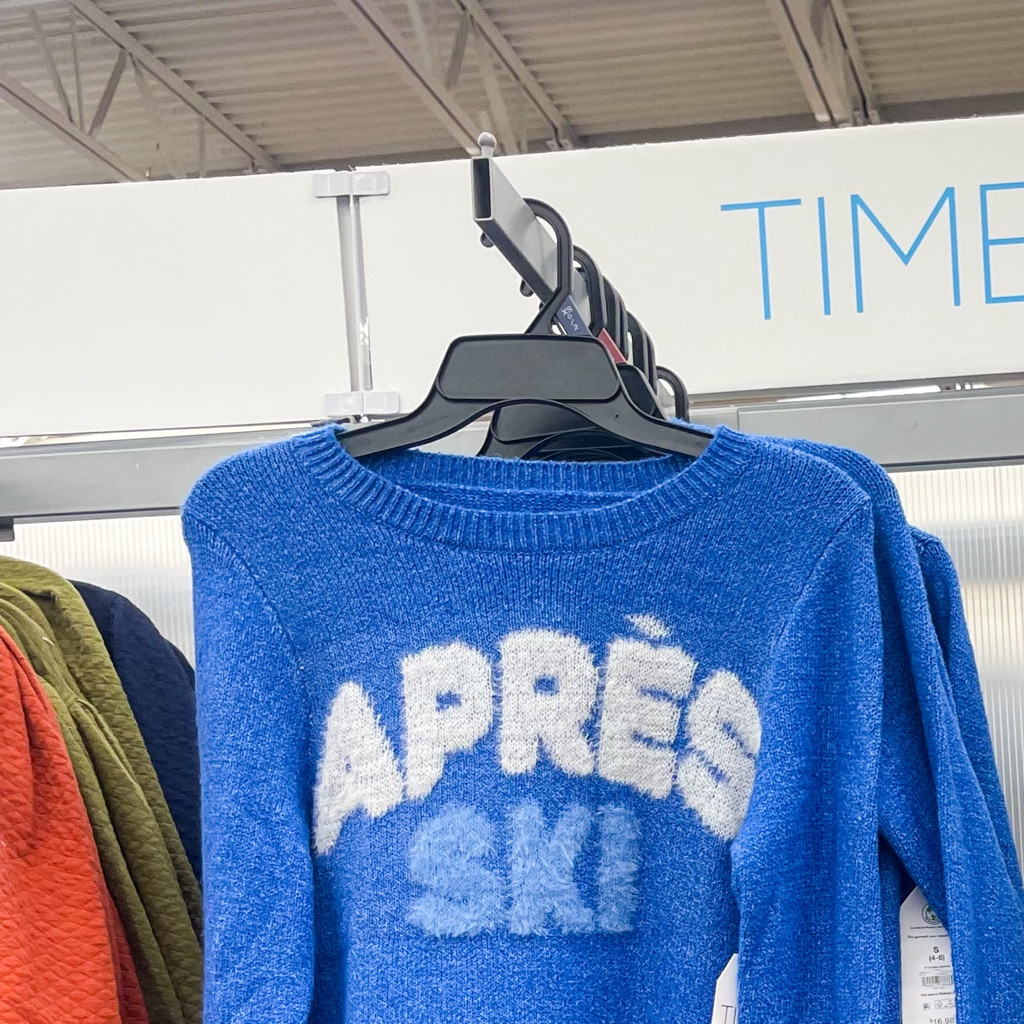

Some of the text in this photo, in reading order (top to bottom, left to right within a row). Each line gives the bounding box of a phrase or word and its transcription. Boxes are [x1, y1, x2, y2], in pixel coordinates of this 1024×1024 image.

[312, 612, 762, 855] APRÈS
[406, 802, 642, 938] SKI
[721, 1005, 738, 1024] TI
